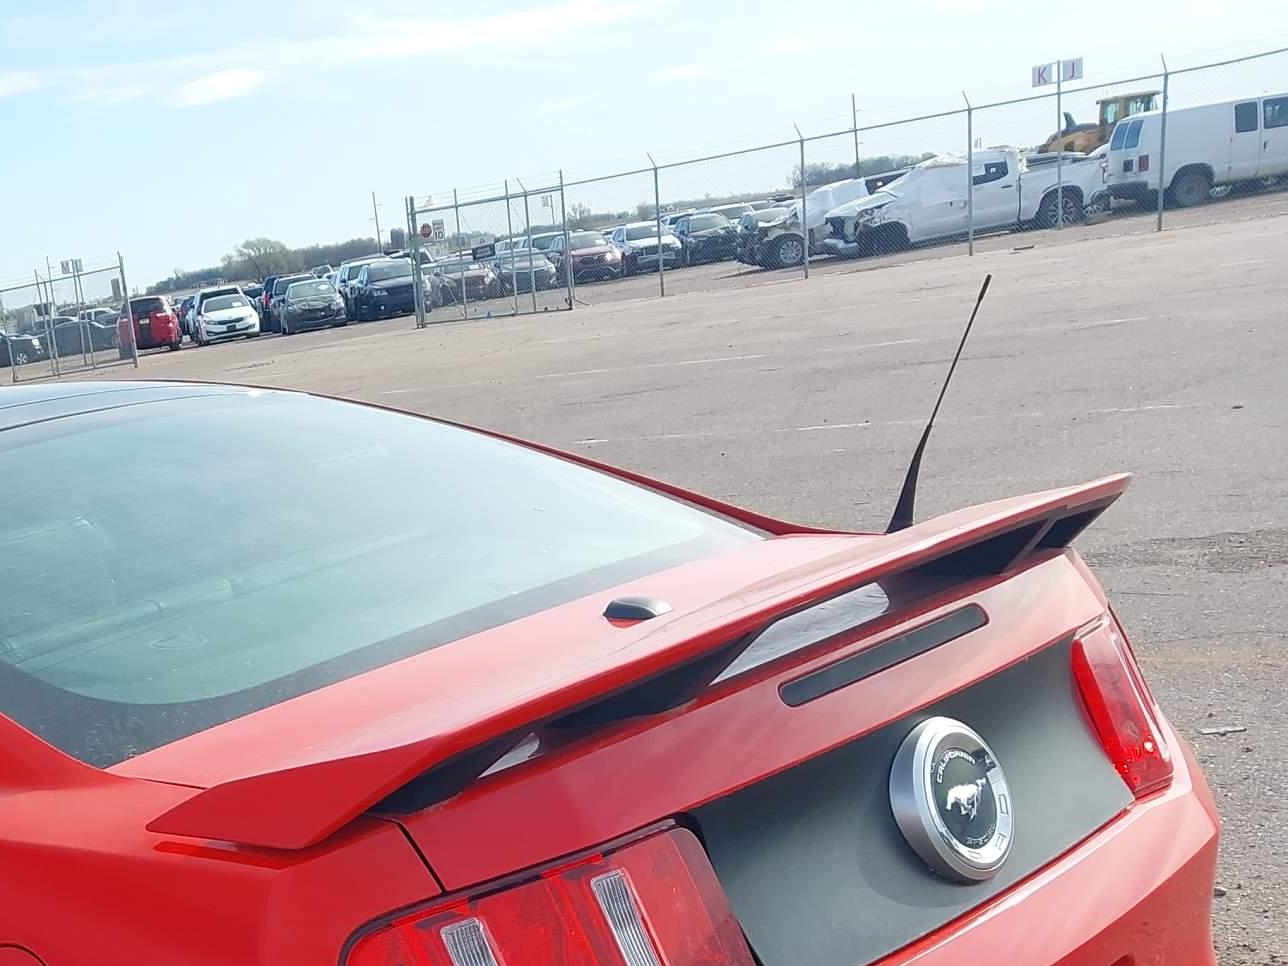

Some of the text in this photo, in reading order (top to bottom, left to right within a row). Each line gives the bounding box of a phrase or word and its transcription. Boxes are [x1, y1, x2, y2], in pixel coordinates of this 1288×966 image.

[1038, 66, 1048, 85] K
[1069, 61, 1075, 79] J
[434, 230, 444, 241] 10
